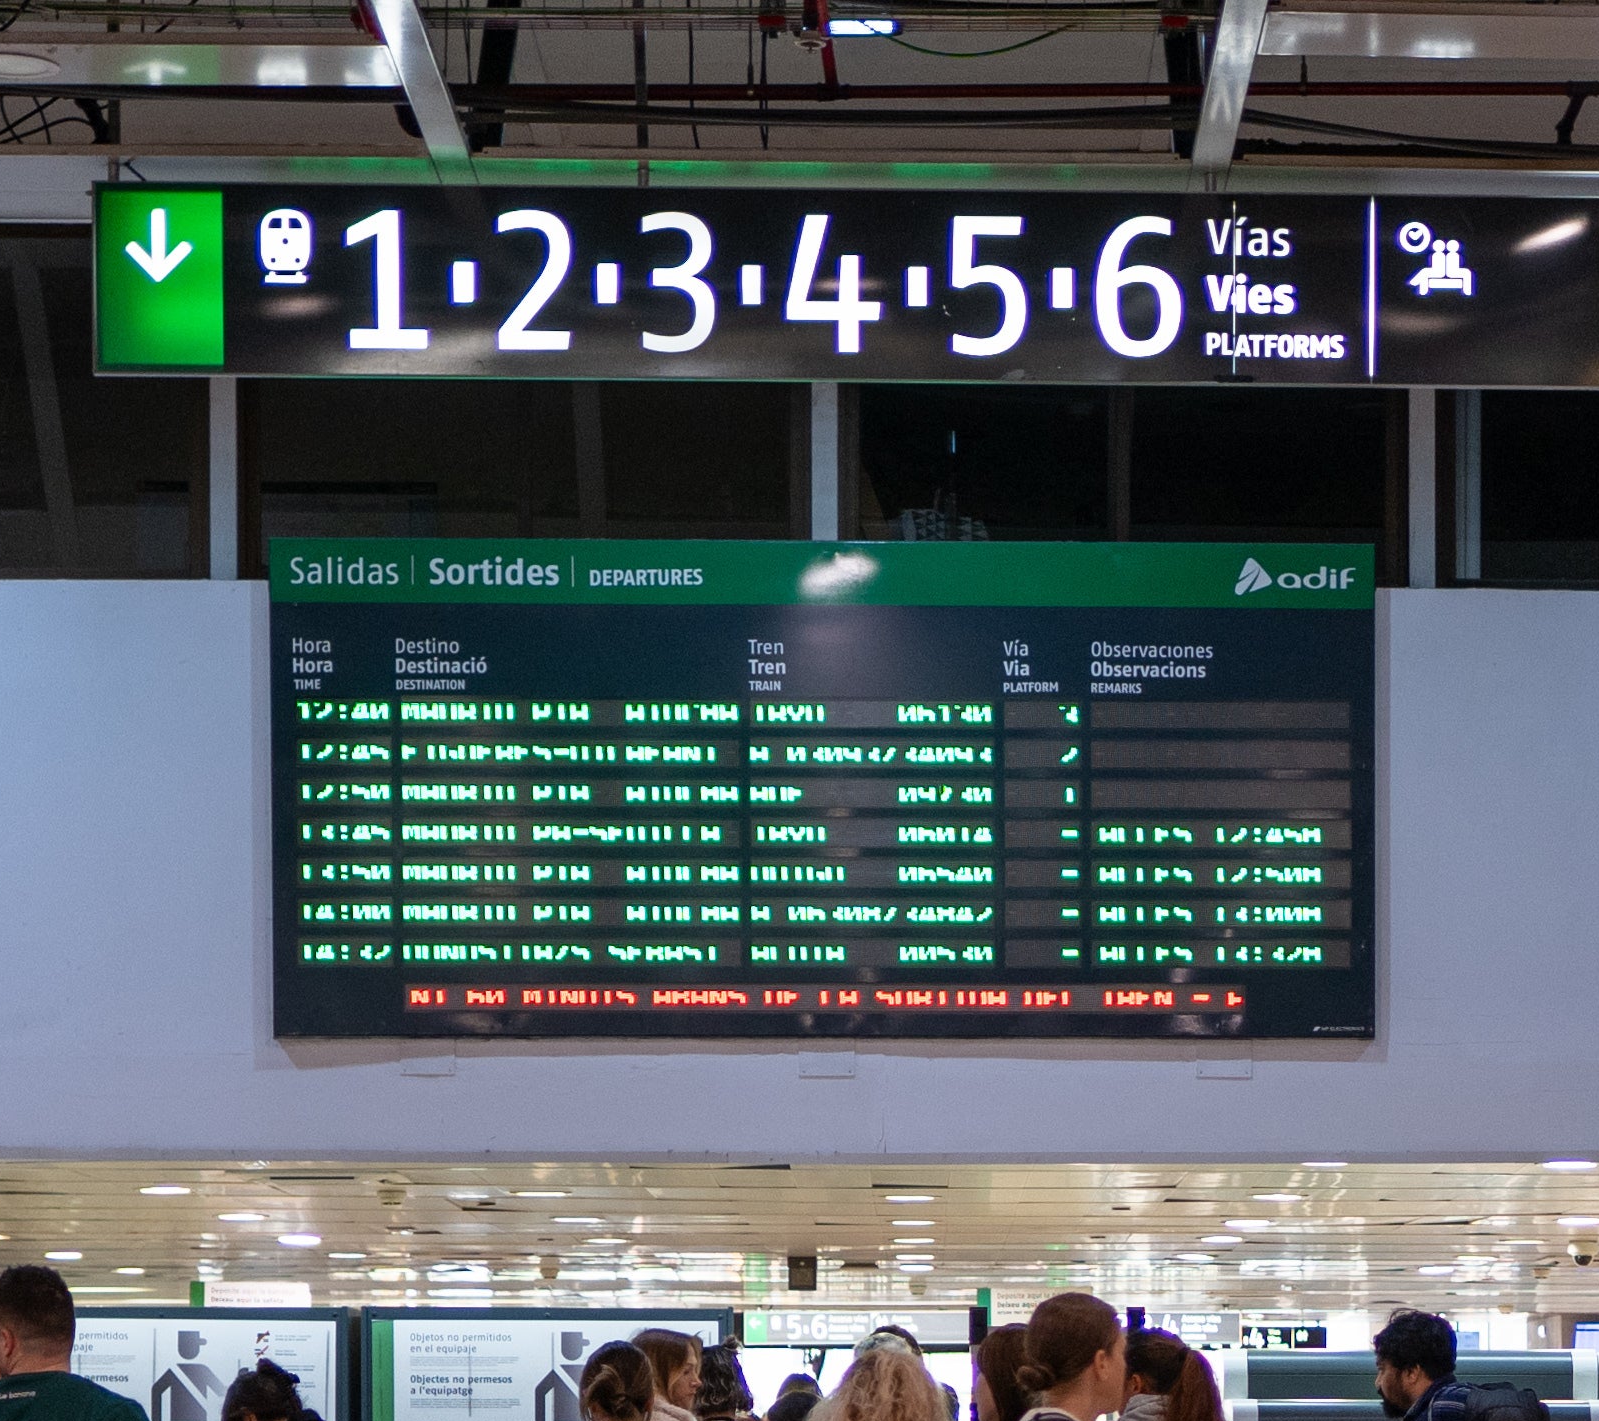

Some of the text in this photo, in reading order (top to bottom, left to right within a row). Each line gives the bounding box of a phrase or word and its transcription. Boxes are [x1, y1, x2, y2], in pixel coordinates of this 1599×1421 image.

[1206, 211, 1292, 258] Vías
[1205, 272, 1297, 316] Vies
[1204, 332, 1347, 359] PLATFORMS
[290, 555, 704, 587] Salidas Sortides DEPARTURES
[1276, 565, 1356, 590] adif
[292, 637, 332, 654] Hora
[395, 637, 460, 655] Destino
[747, 638, 785, 656] Tren
[1002, 639, 1029, 657] Vía
[1090, 640, 1214, 659] Observaciones
[292, 657, 334, 674] Hora
[395, 656, 488, 674] Destinació
[748, 658, 787, 675] Tren
[1003, 659, 1030, 677] Via
[1090, 660, 1207, 679] Observacions
[293, 678, 321, 690] TIME
[395, 678, 466, 691] DESTINATION
[748, 680, 782, 691] TRAIN
[1002, 681, 1059, 694] PLATFORM
[1090, 682, 1143, 694] REMARKS
[409, 1332, 512, 1343] Objetos no permitidos
[409, 1344, 477, 1354] en el equipaje
[409, 1374, 513, 1385] Objectes no permesos
